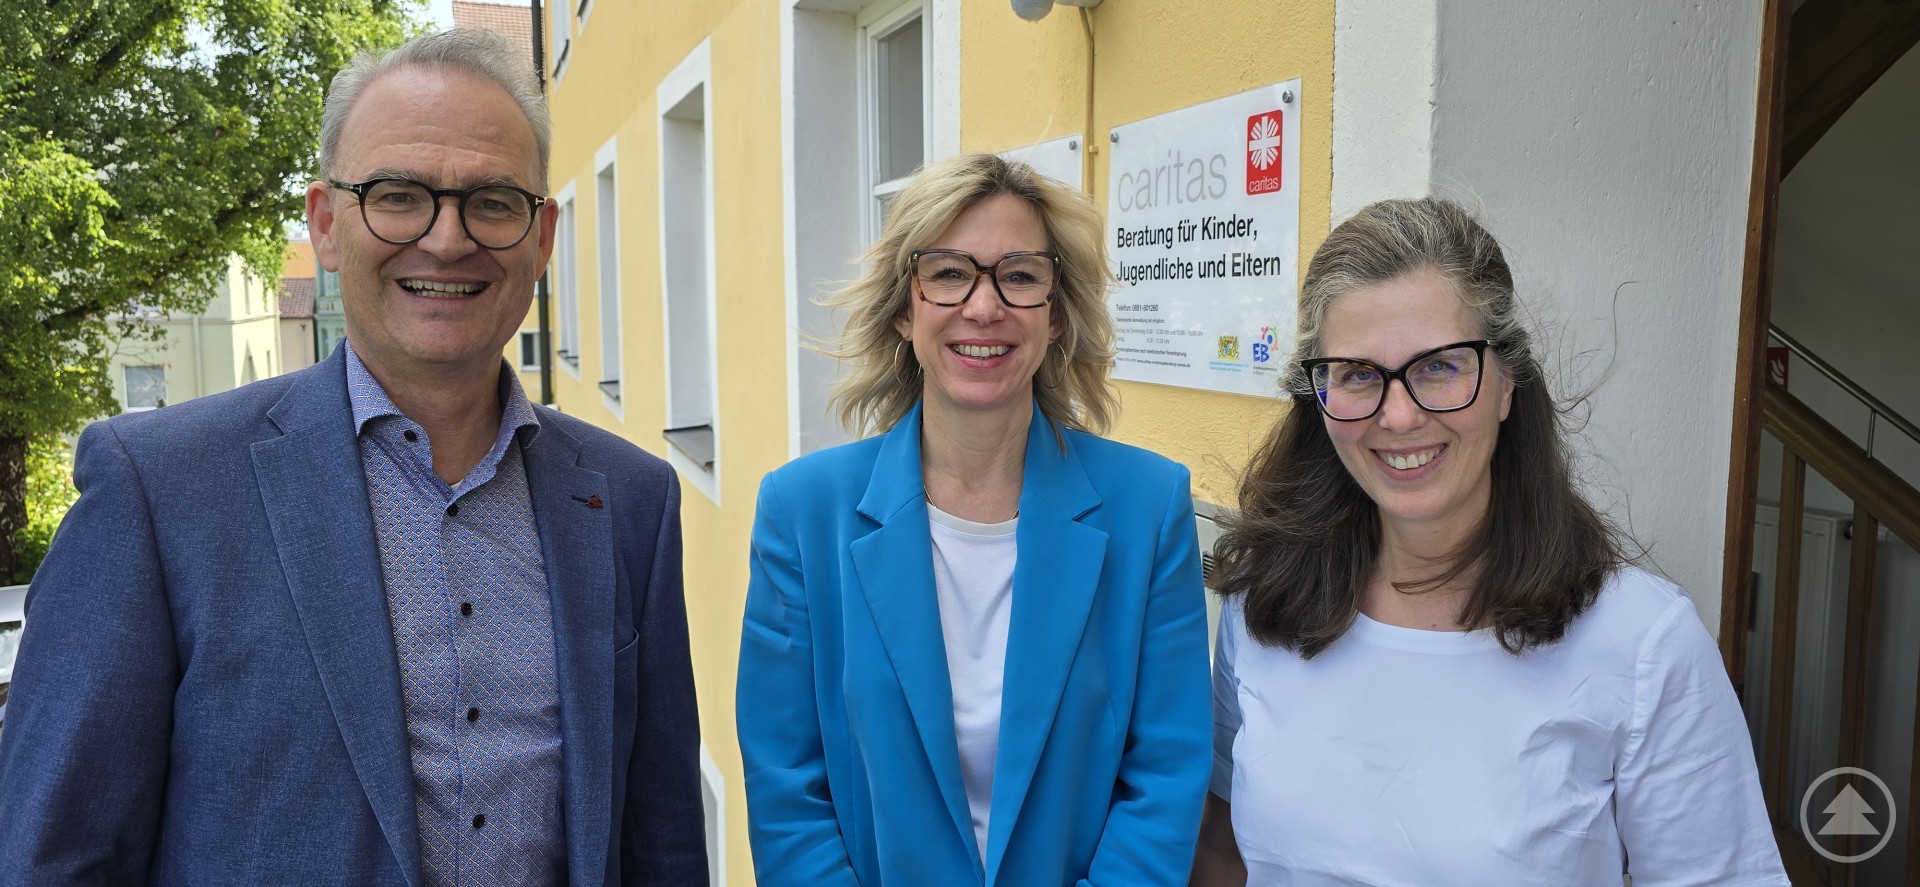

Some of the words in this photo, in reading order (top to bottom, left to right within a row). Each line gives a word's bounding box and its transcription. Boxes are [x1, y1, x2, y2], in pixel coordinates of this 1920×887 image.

[1117, 149, 1228, 212] caritas
[1249, 176, 1279, 192] caritas
[1117, 225, 1173, 249] Beratung
[1177, 220, 1197, 242] für
[1201, 213, 1258, 241] Kinder,
[1116, 257, 1194, 286] Jugendliche
[1198, 253, 1226, 279] und
[1231, 252, 1281, 277] Eltern
[1252, 342, 1270, 363] EB
